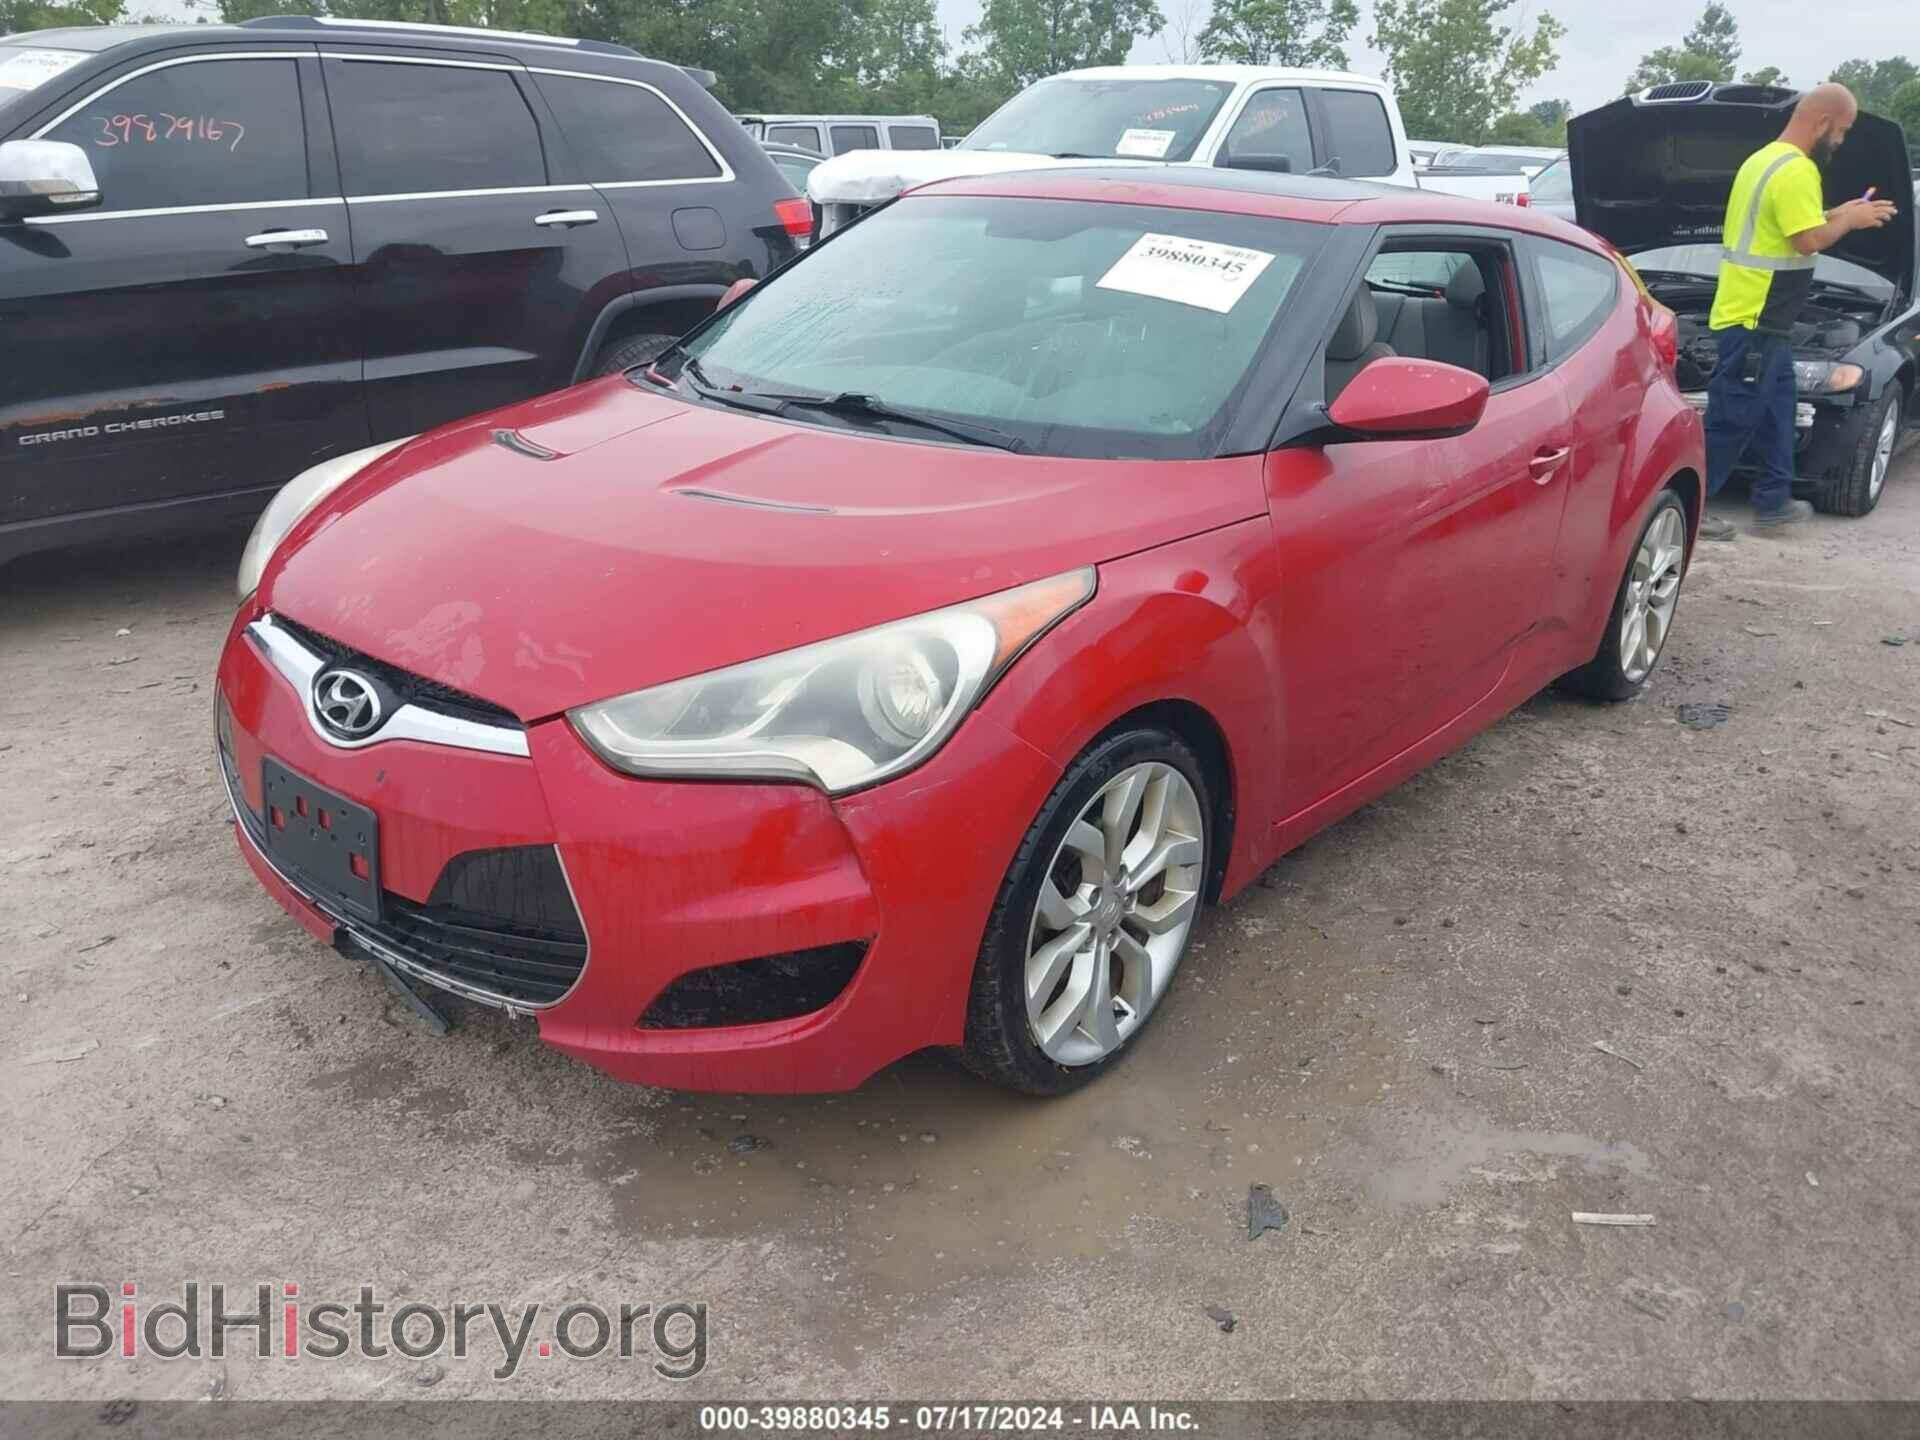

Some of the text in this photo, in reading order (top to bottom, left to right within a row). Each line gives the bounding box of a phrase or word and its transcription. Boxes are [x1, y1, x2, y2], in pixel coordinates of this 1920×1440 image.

[92, 112, 245, 152] 39879167
[1140, 246, 1247, 273] 39880345
[19, 409, 225, 445] GRAND CHEROKEE
